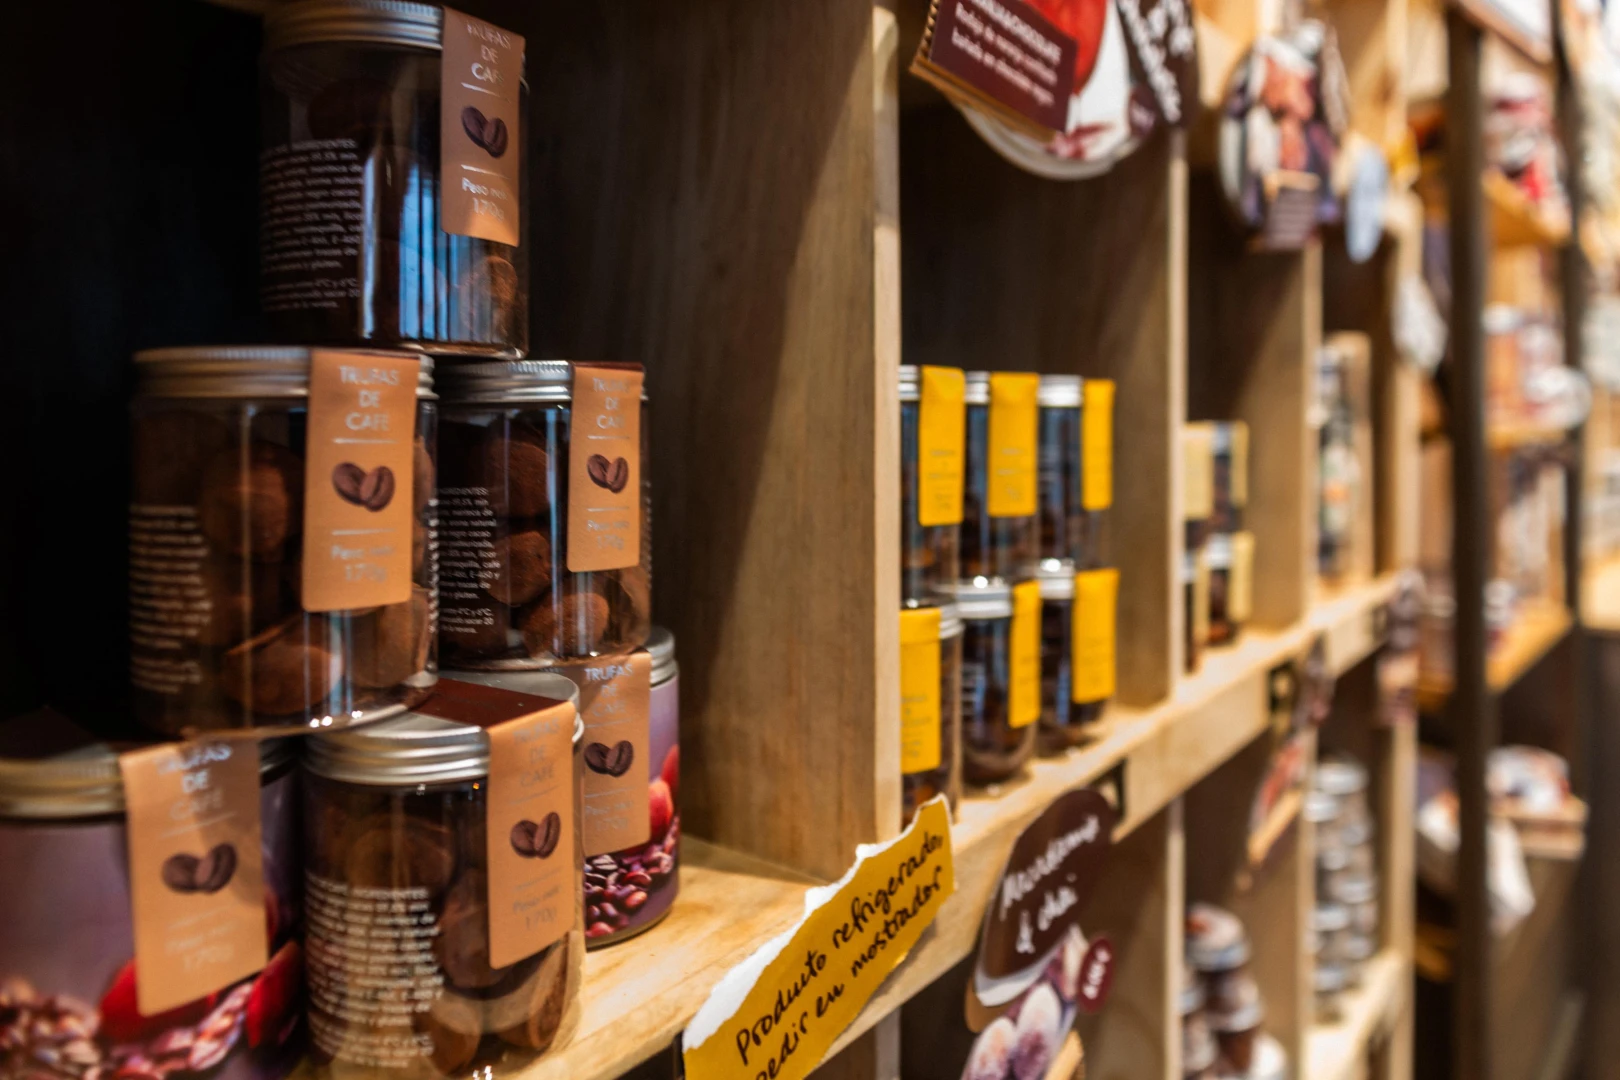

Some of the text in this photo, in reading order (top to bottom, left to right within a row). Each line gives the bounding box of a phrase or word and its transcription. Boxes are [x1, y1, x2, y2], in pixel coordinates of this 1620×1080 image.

[339, 365, 399, 386] TRUFAS
[358, 389, 379, 408] DE
[584, 663, 633, 682] TRUFAS
[182, 767, 209, 794] DE
[815, 983, 845, 1018] en
[850, 865, 942, 977] mostrador
[736, 950, 827, 1067] Producto
